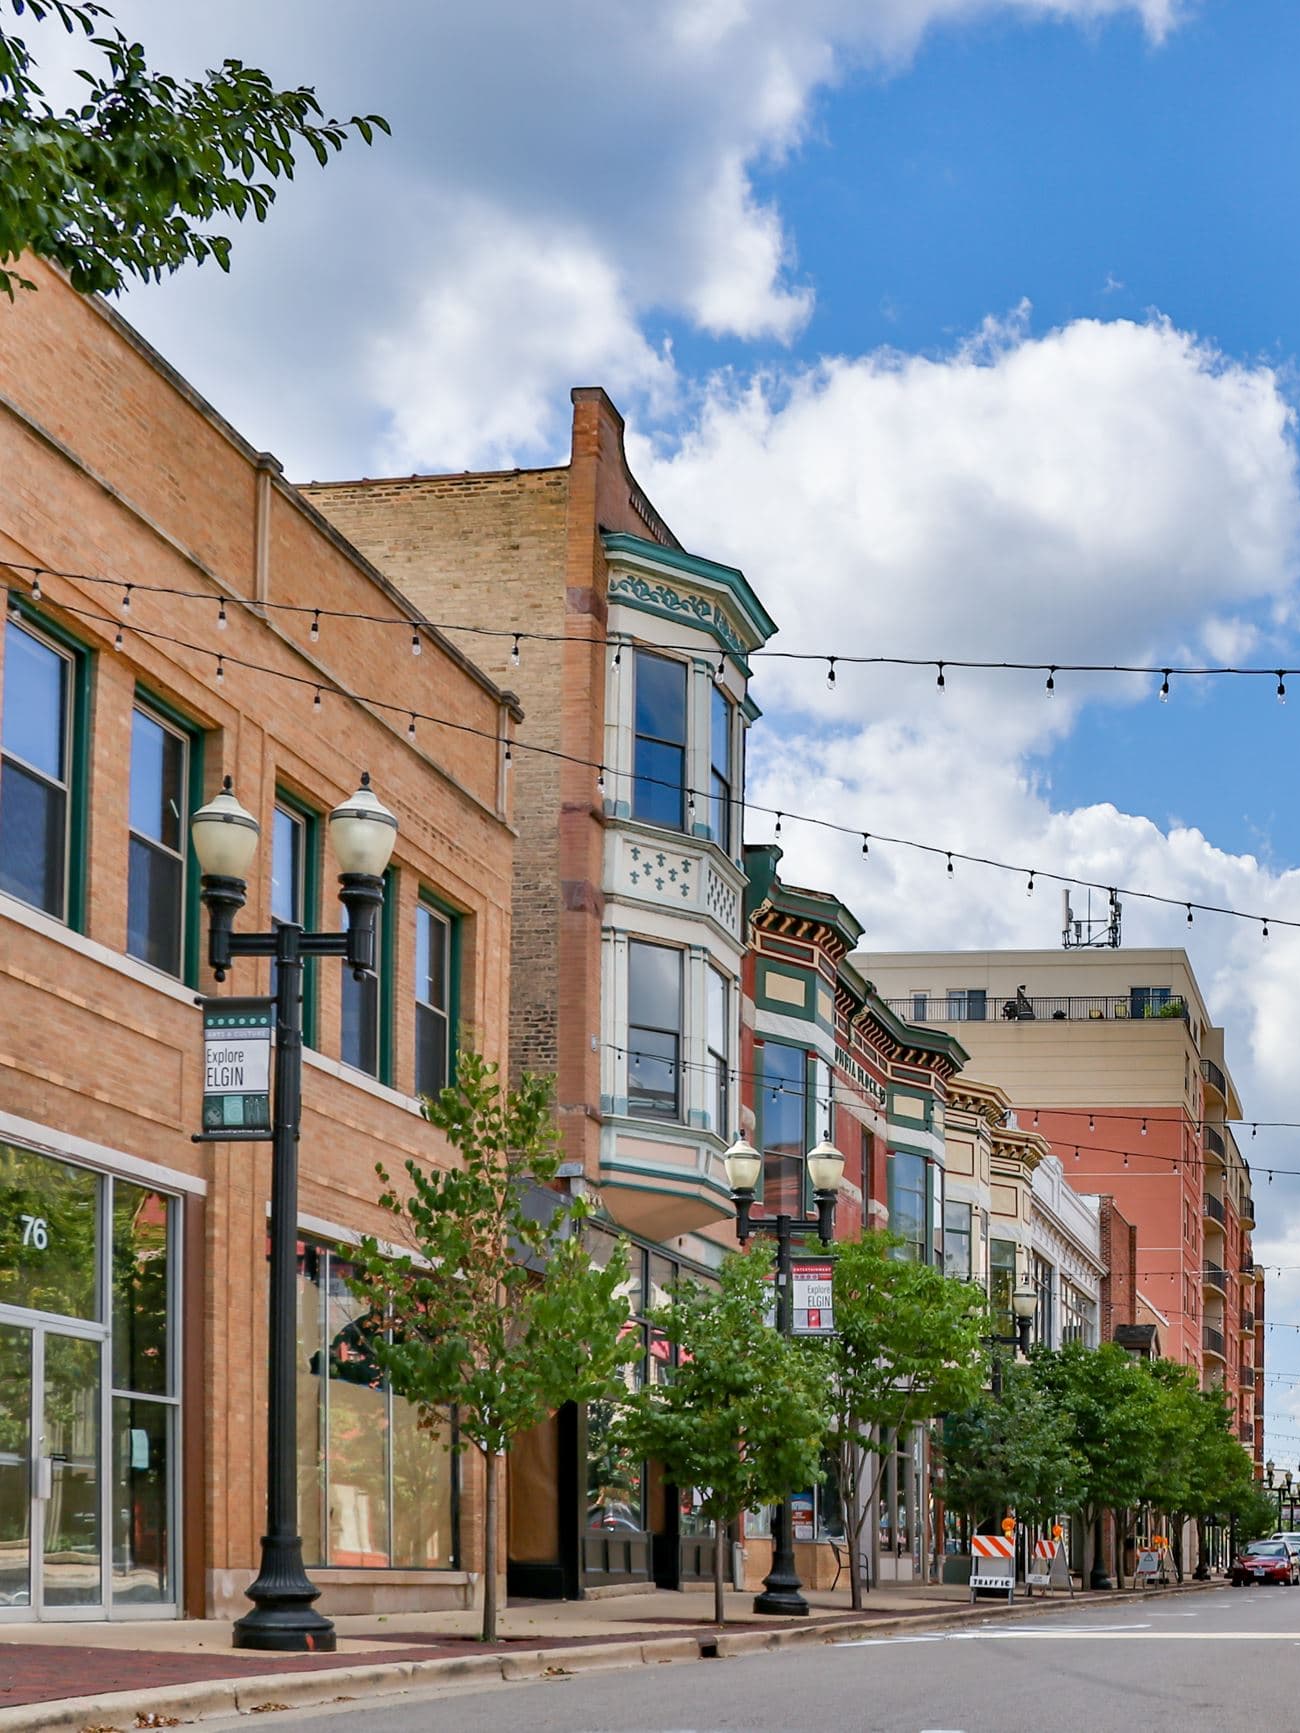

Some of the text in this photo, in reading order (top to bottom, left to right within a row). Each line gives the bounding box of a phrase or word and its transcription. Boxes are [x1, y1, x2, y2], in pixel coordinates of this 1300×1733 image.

[207, 1048, 244, 1065] Explore
[207, 1067, 244, 1087] ELGIN
[21, 1214, 48, 1250] 76
[807, 1285, 831, 1295] Explore
[807, 1295, 831, 1308] ELGIN
[973, 1578, 1011, 1587] TRAFFIC
